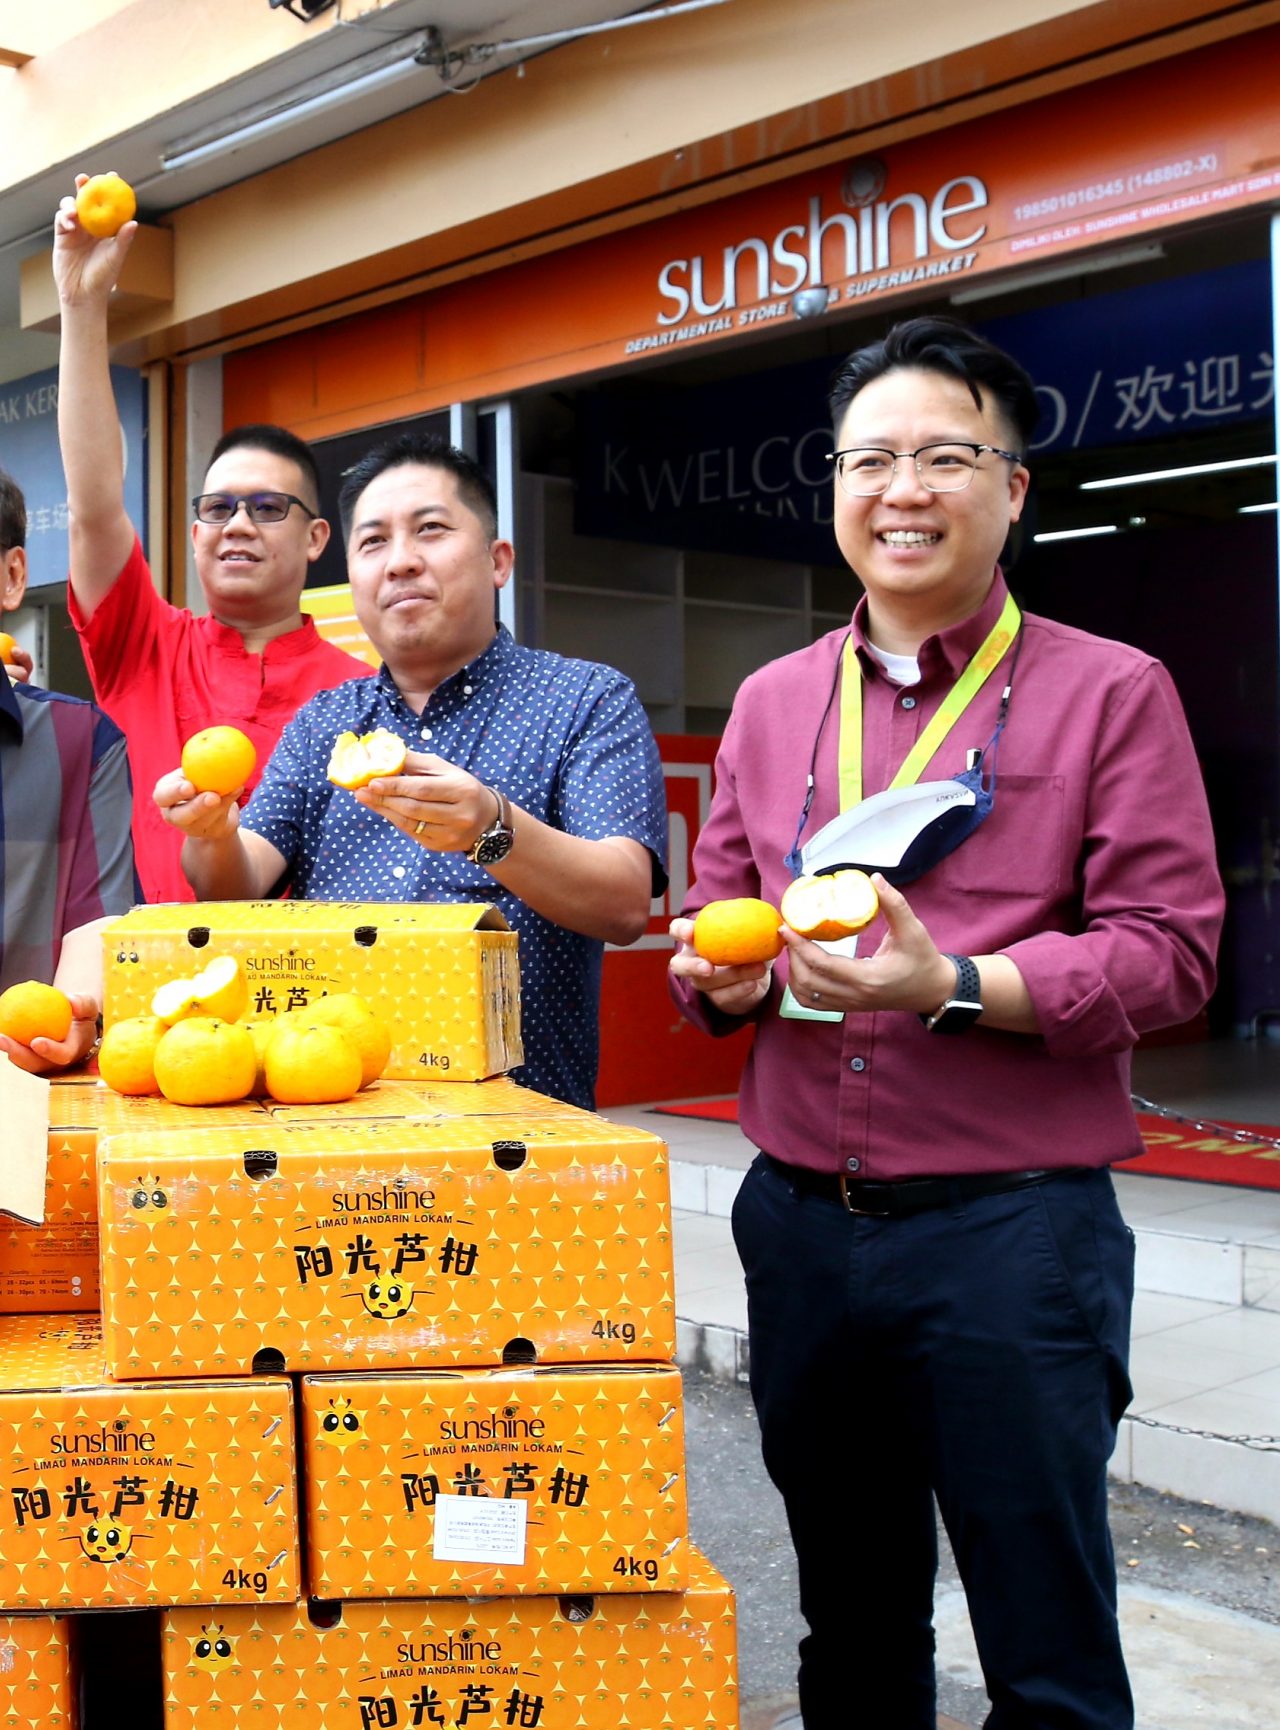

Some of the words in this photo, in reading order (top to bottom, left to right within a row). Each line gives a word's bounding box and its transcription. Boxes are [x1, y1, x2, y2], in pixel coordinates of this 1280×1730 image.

[656, 175, 988, 326] sunshine
[624, 318, 733, 354] DEPARTMENTAL
[739, 302, 787, 325] STORE
[846, 252, 979, 297] SUPERMARKET
[246, 952, 315, 971] sunshine
[419, 1053, 449, 1070] 4kg
[332, 1186, 436, 1212] sunshine
[316, 1218, 348, 1228] LIMAU
[353, 1215, 410, 1225] MANDARIN
[414, 1215, 452, 1224] LOKAM
[294, 1233, 478, 1284] 阳光芦柑
[592, 1320, 635, 1344] 4kg
[440, 1413, 545, 1439] sunshine
[50, 1428, 154, 1454] sunshine
[423, 1447, 456, 1456] LIMAU
[461, 1443, 519, 1454] MANDARIN
[523, 1444, 563, 1454] LOKAM
[34, 1459, 67, 1470] LIMAU
[71, 1457, 131, 1467] MANDARIN
[133, 1457, 173, 1467] LOKAM
[11, 1475, 199, 1526] 阳光芦柑
[223, 1567, 270, 1593] 4kg
[614, 1557, 658, 1581] 4kg
[397, 1638, 502, 1663] sunshine
[380, 1668, 414, 1679] LIMAU
[418, 1665, 476, 1676] MANDARIN
[480, 1666, 519, 1676] LOKAM
